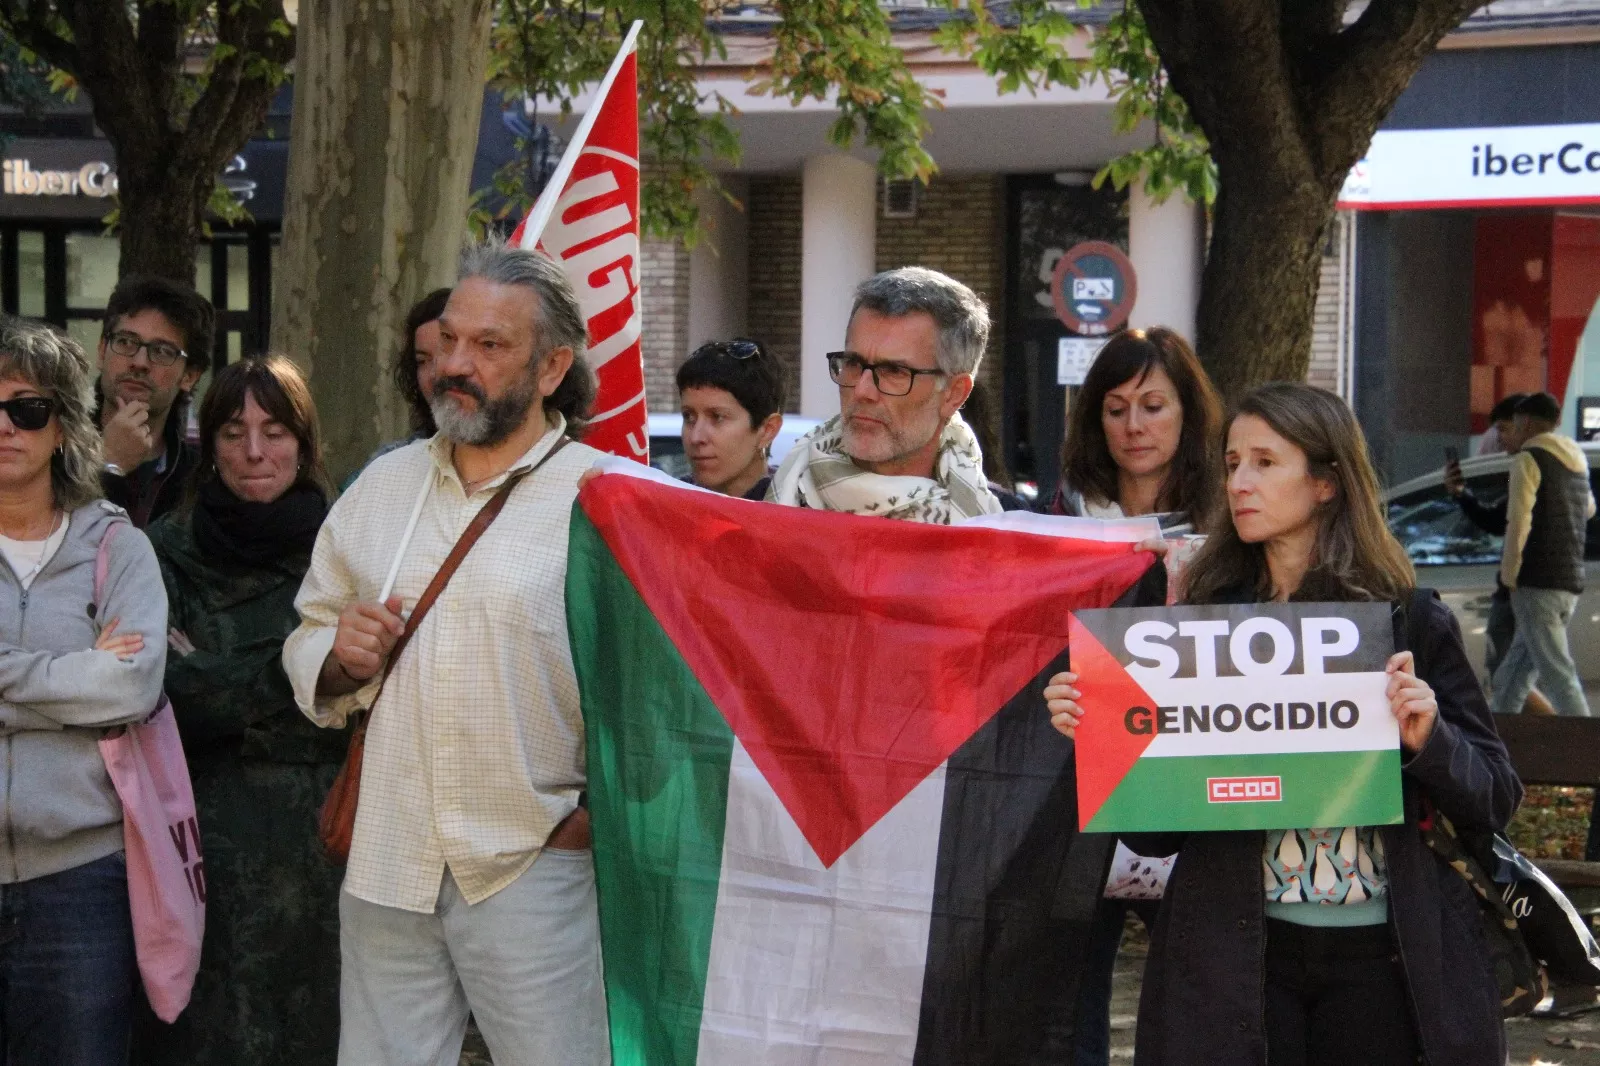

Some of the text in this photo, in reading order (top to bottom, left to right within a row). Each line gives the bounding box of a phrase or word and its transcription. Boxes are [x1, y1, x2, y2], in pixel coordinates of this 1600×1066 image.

[540, 170, 642, 388] UGT
[1124, 616, 1360, 680] STOP
[1124, 700, 1360, 735] GENOCIDIO
[1210, 780, 1278, 800] CCOO
